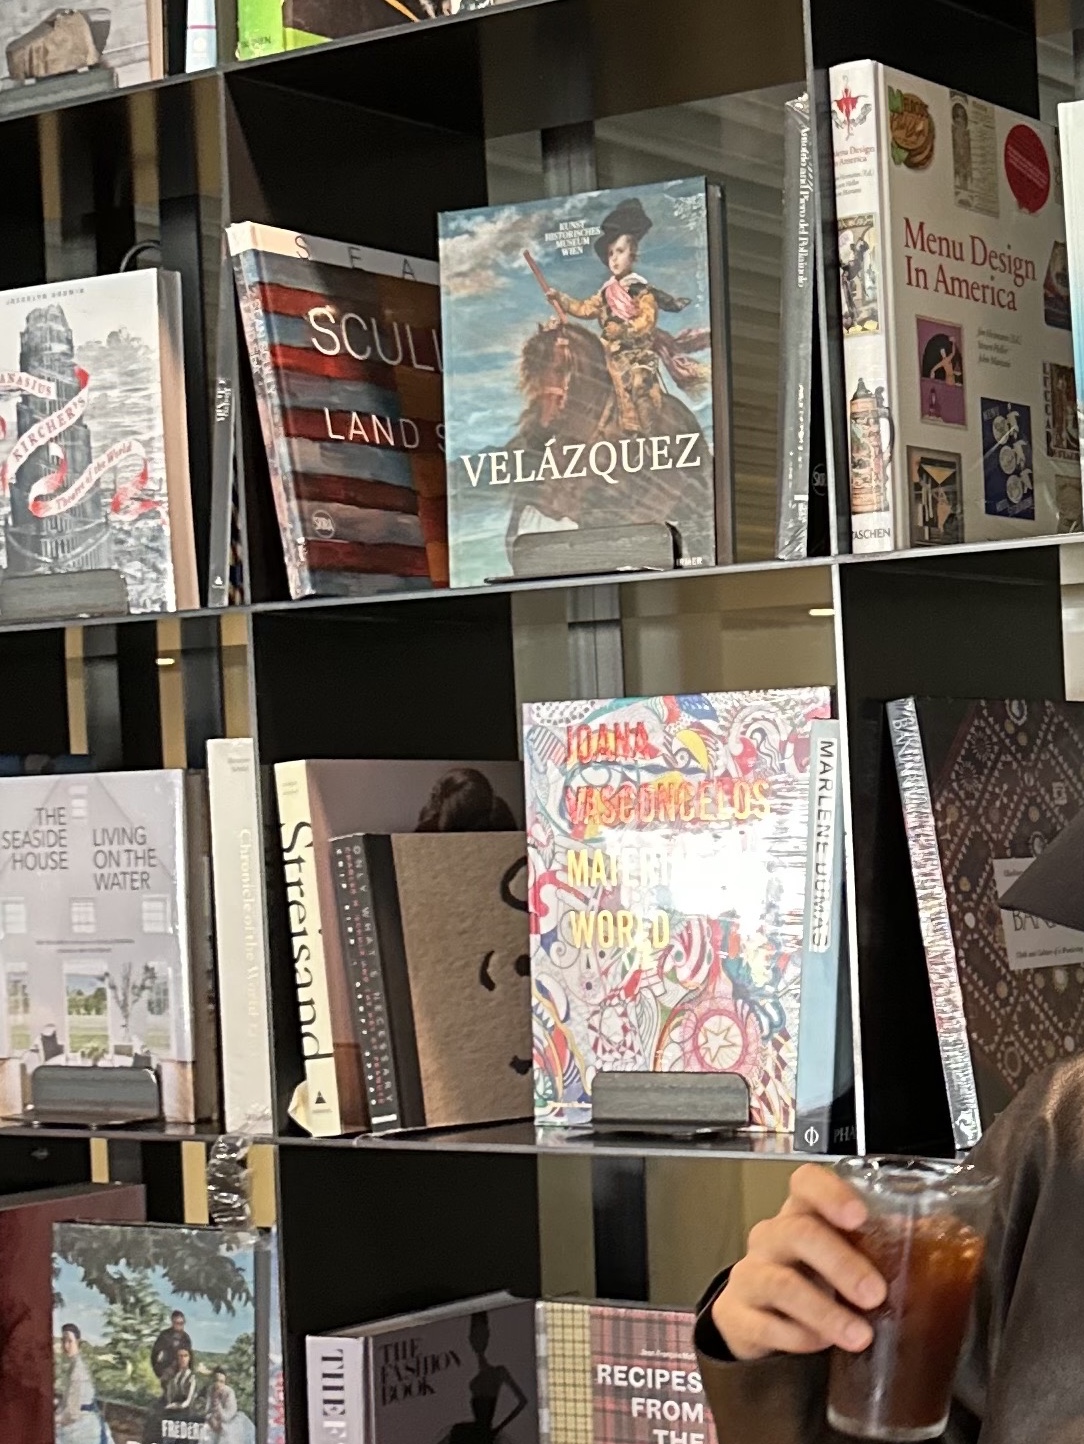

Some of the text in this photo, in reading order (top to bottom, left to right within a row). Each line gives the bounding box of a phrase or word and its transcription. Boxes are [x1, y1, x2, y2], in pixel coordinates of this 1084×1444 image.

[799, 166, 810, 188] and
[559, 219, 586, 231] KUNST
[799, 218, 809, 234] del
[555, 236, 590, 249] MUSEUM
[561, 247, 583, 256] WIEN
[903, 217, 1038, 288] Menu Design
[905, 255, 1018, 312] In America
[324, 407, 420, 449] LAND
[460, 432, 701, 488] VELÁZQUEZ
[565, 721, 651, 764] JOANA
[565, 779, 771, 824] VASCONCELOS
[816, 740, 835, 859] MARLENE
[35, 806, 67, 826] THE
[2, 829, 68, 849] SEASIDE
[92, 826, 147, 847] LIVING
[11, 851, 69, 871] HOUSE
[93, 848, 158, 869] ON THE
[93, 871, 151, 891] WATER
[280, 820, 334, 1061] Streisand
[321, 1348, 346, 1416] THE
[596, 1363, 704, 1394] RECIPES
[631, 1397, 704, 1424] FROM
